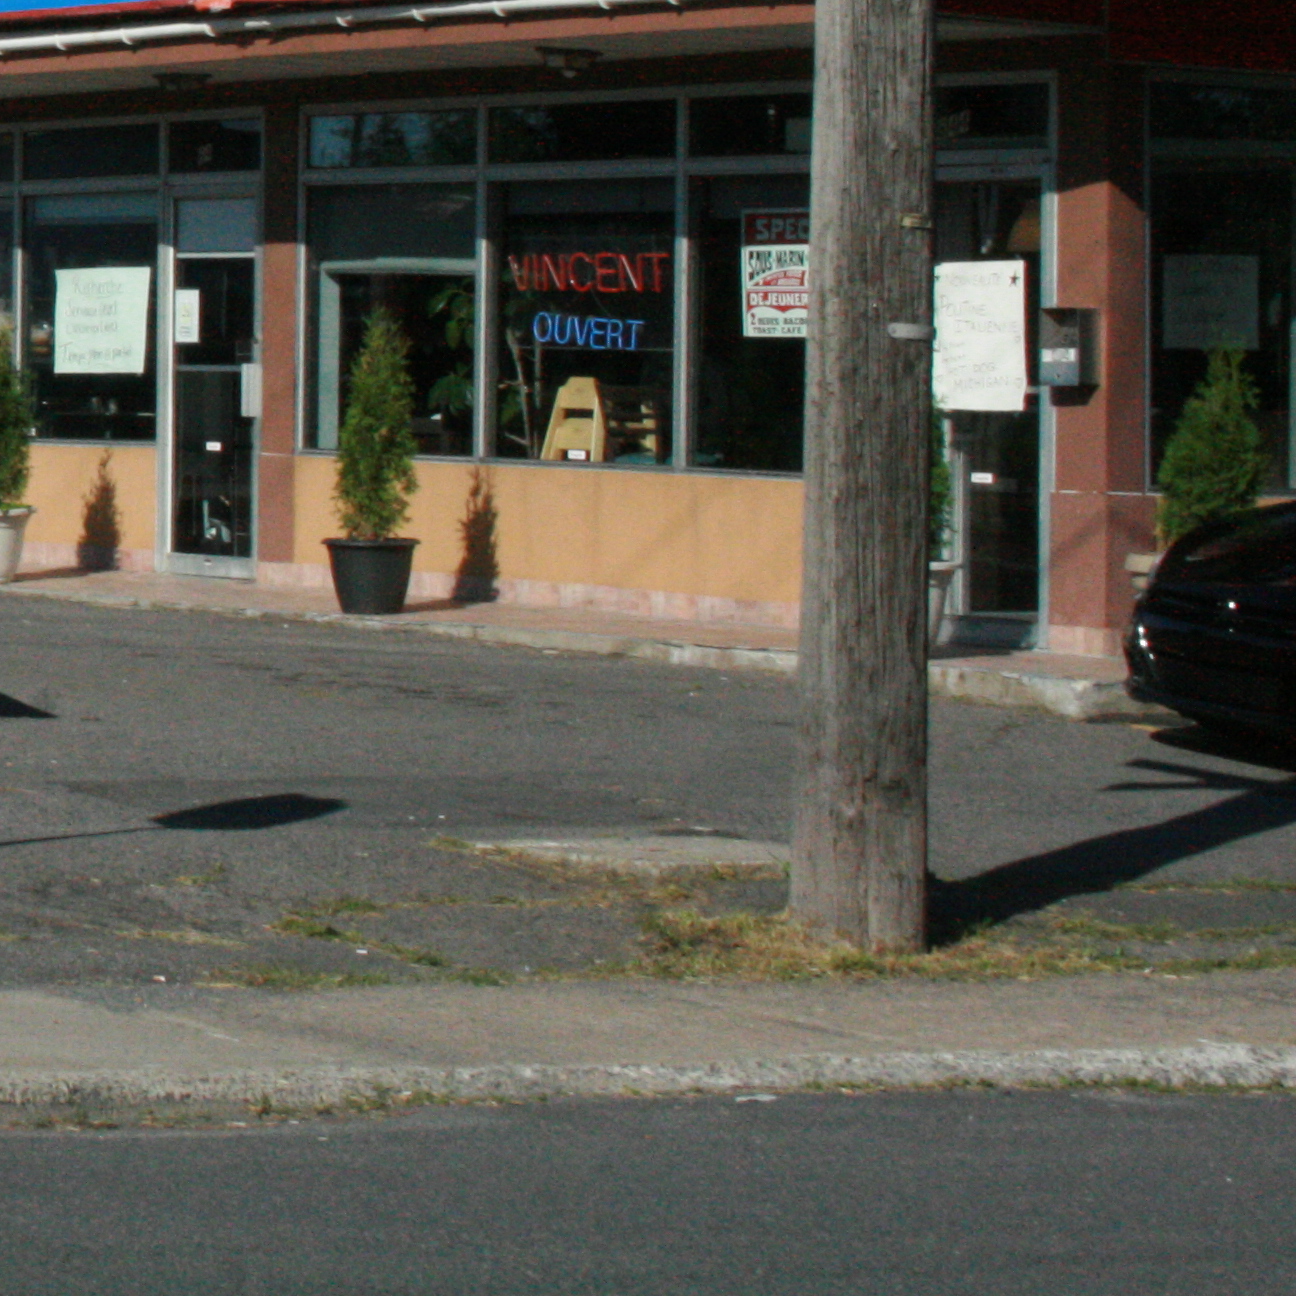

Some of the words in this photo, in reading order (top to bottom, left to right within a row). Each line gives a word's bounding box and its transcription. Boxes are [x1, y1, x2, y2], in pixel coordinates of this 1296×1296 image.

[755, 218, 809, 240] SPEC
[509, 252, 670, 293] VINCENT
[533, 312, 644, 350] OUVERT
